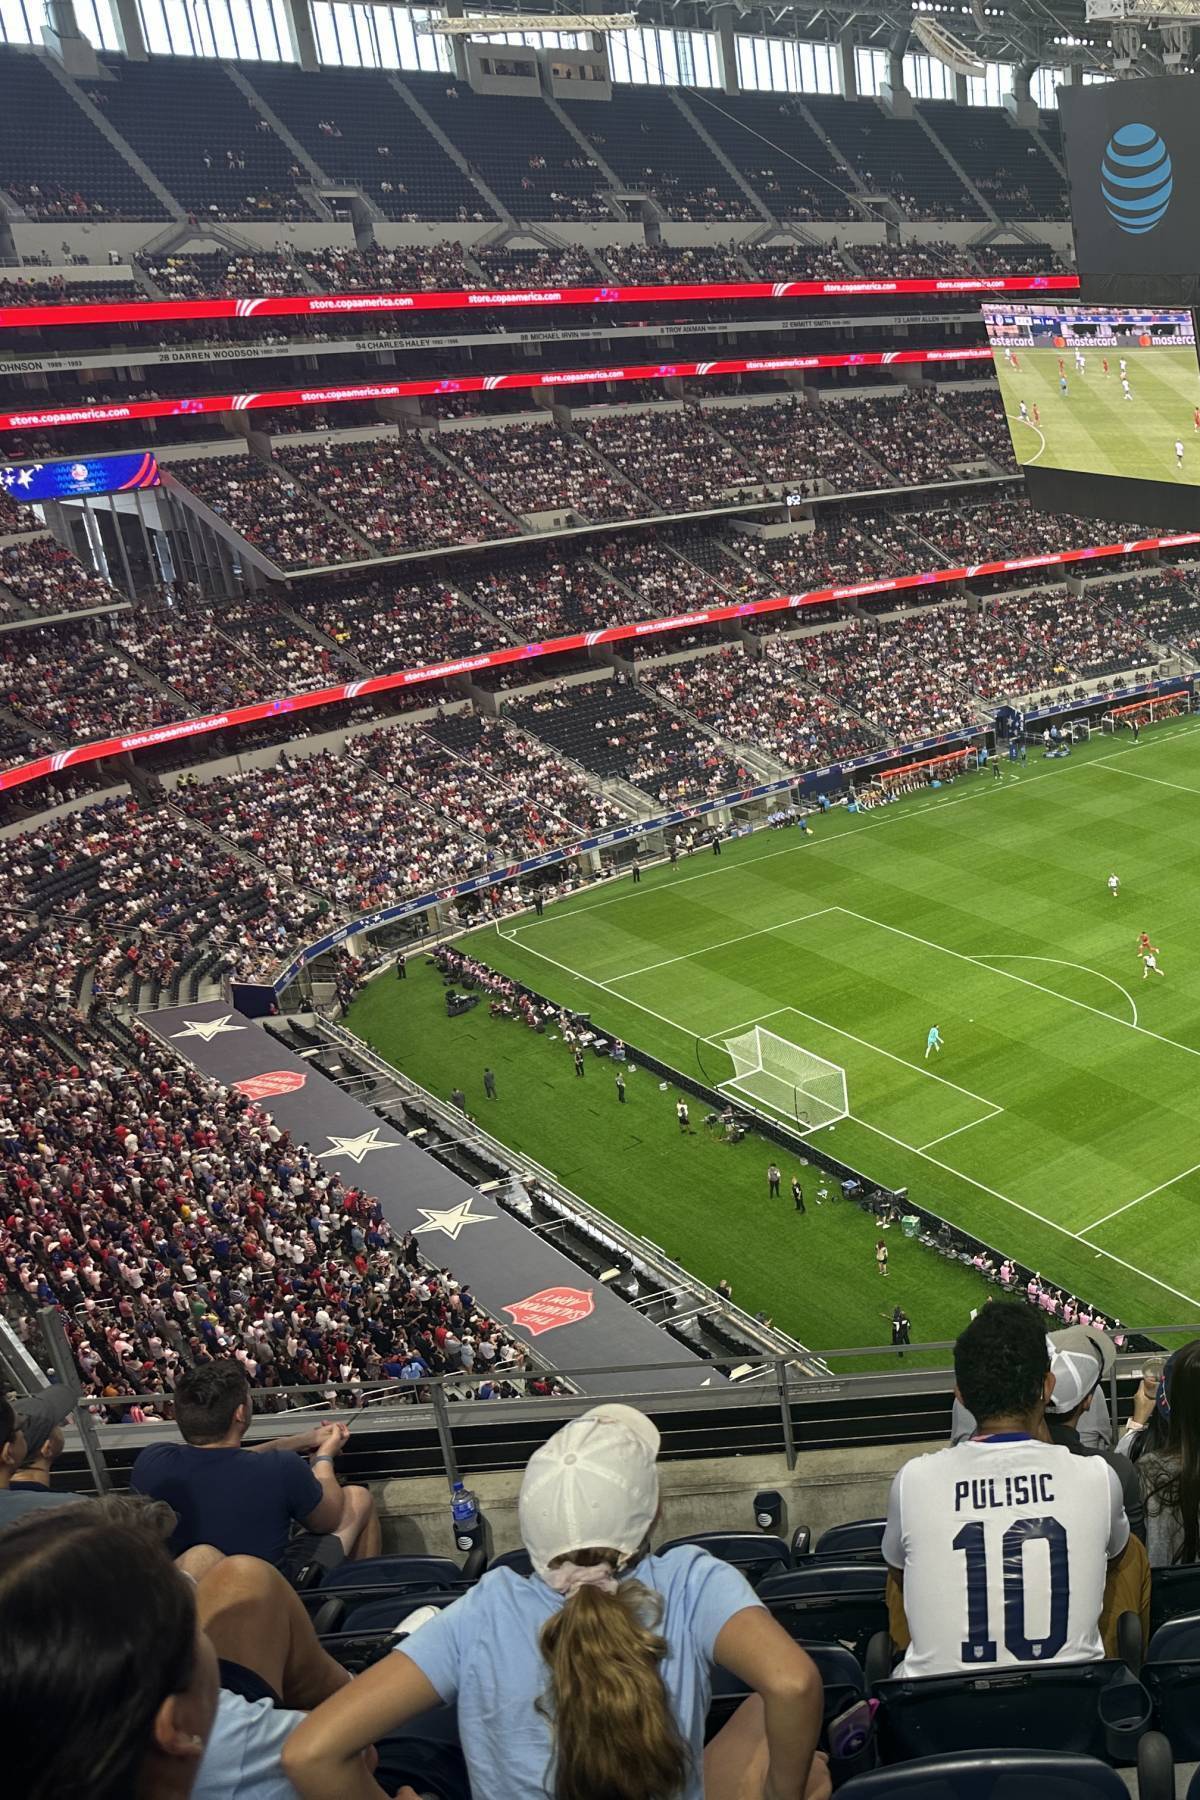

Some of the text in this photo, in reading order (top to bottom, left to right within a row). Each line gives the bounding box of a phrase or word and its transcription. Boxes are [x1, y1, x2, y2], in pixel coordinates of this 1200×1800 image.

[309, 296, 414, 310] store.copaamerica.com
[469, 291, 561, 304] store.copaamerica.com
[530, 333, 560, 341] MICHAEL
[1066, 336, 1117, 347] mastercard
[355, 342, 367, 350] 94
[367, 341, 405, 350] CHARLES
[405, 339, 431, 347] HALEY
[158, 354, 170, 362] 28
[172, 352, 211, 361] DARREN
[212, 349, 260, 359] WOODSON
[541, 370, 624, 383] store.copaamerica.com
[301, 386, 400, 401] store.copaamerica.com
[9, 407, 130, 427] store.copaamerica.com
[121, 716, 228, 748] store.copaamerica.com
[955, 1473, 1054, 1511] PULISIC
[952, 1516, 1069, 1663] 10
